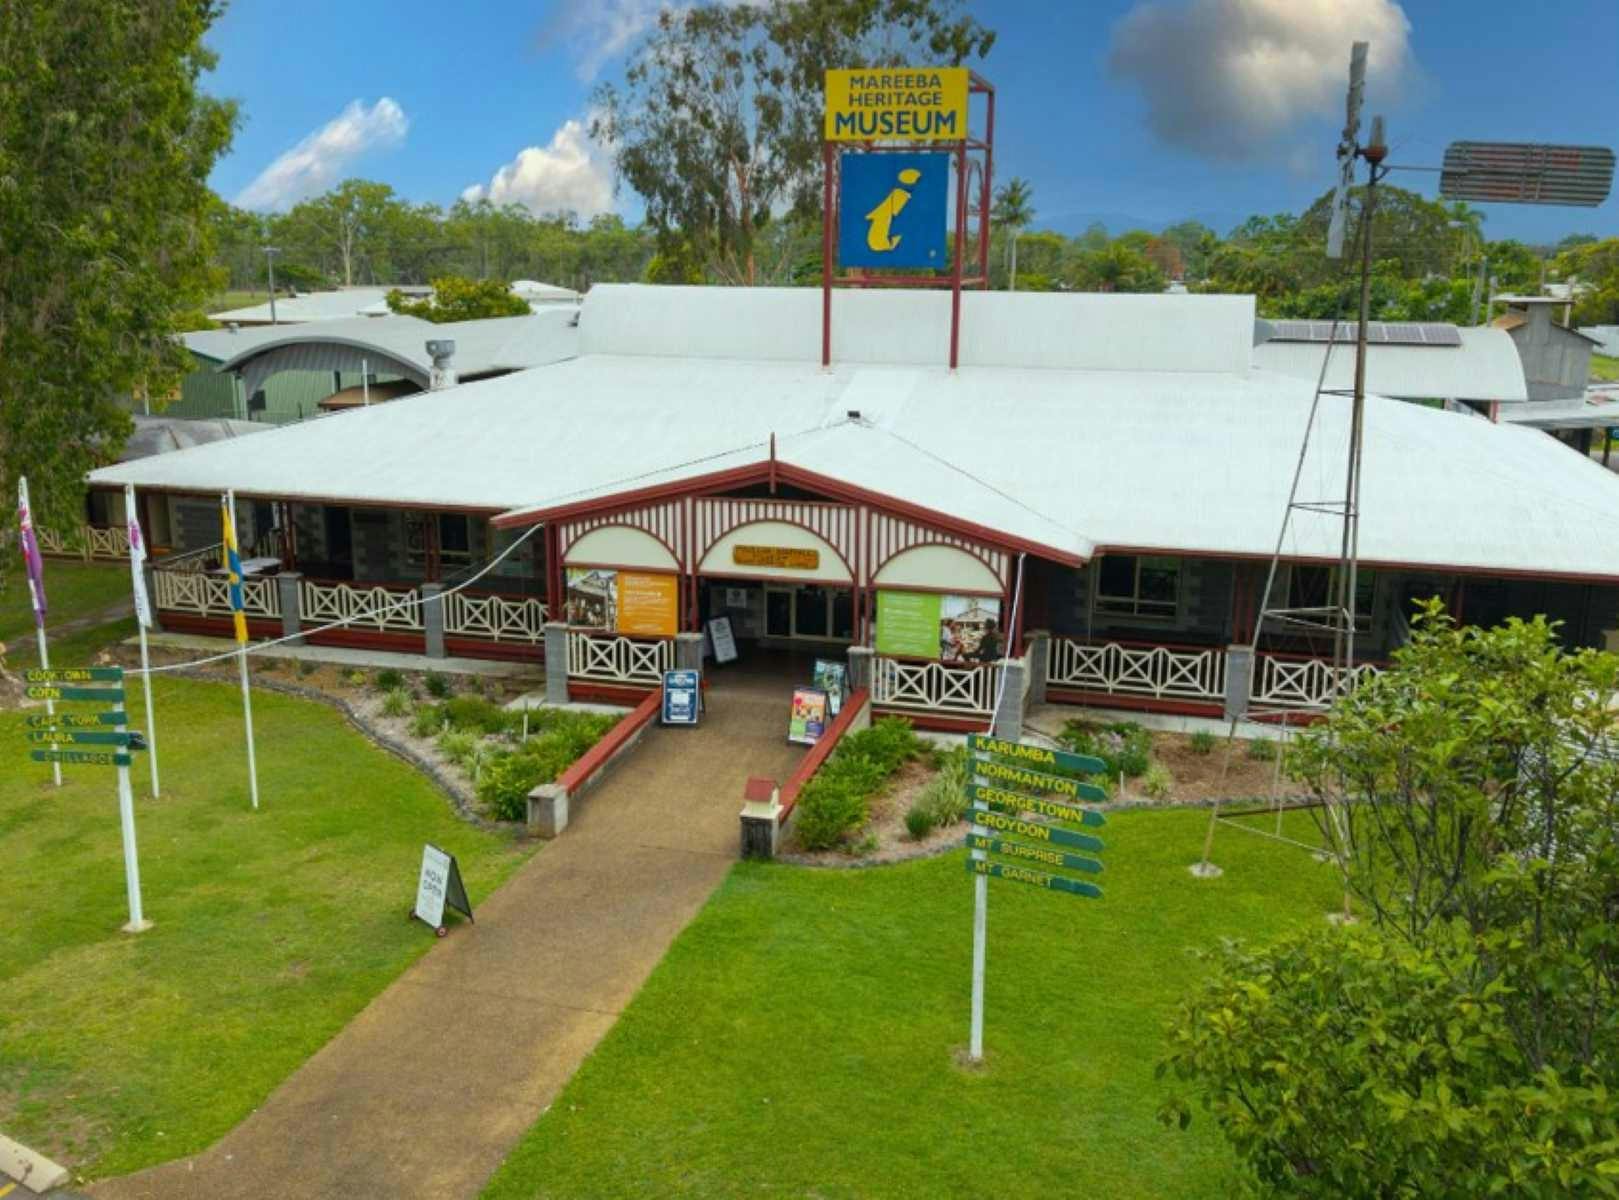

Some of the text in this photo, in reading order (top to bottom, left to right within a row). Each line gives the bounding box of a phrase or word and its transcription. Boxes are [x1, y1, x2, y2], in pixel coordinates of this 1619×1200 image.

[850, 74, 942, 89] MAREEBA
[848, 91, 943, 107] HERITAGE
[835, 110, 957, 135] MUSEUM
[975, 736, 1056, 764] KARUMBA
[975, 761, 1078, 796] NORMANTON
[975, 787, 1083, 822] GEORGETOWN
[975, 812, 1049, 840] CROYDON
[975, 838, 1064, 866] MT SURPRISE
[975, 862, 993, 874] MT
